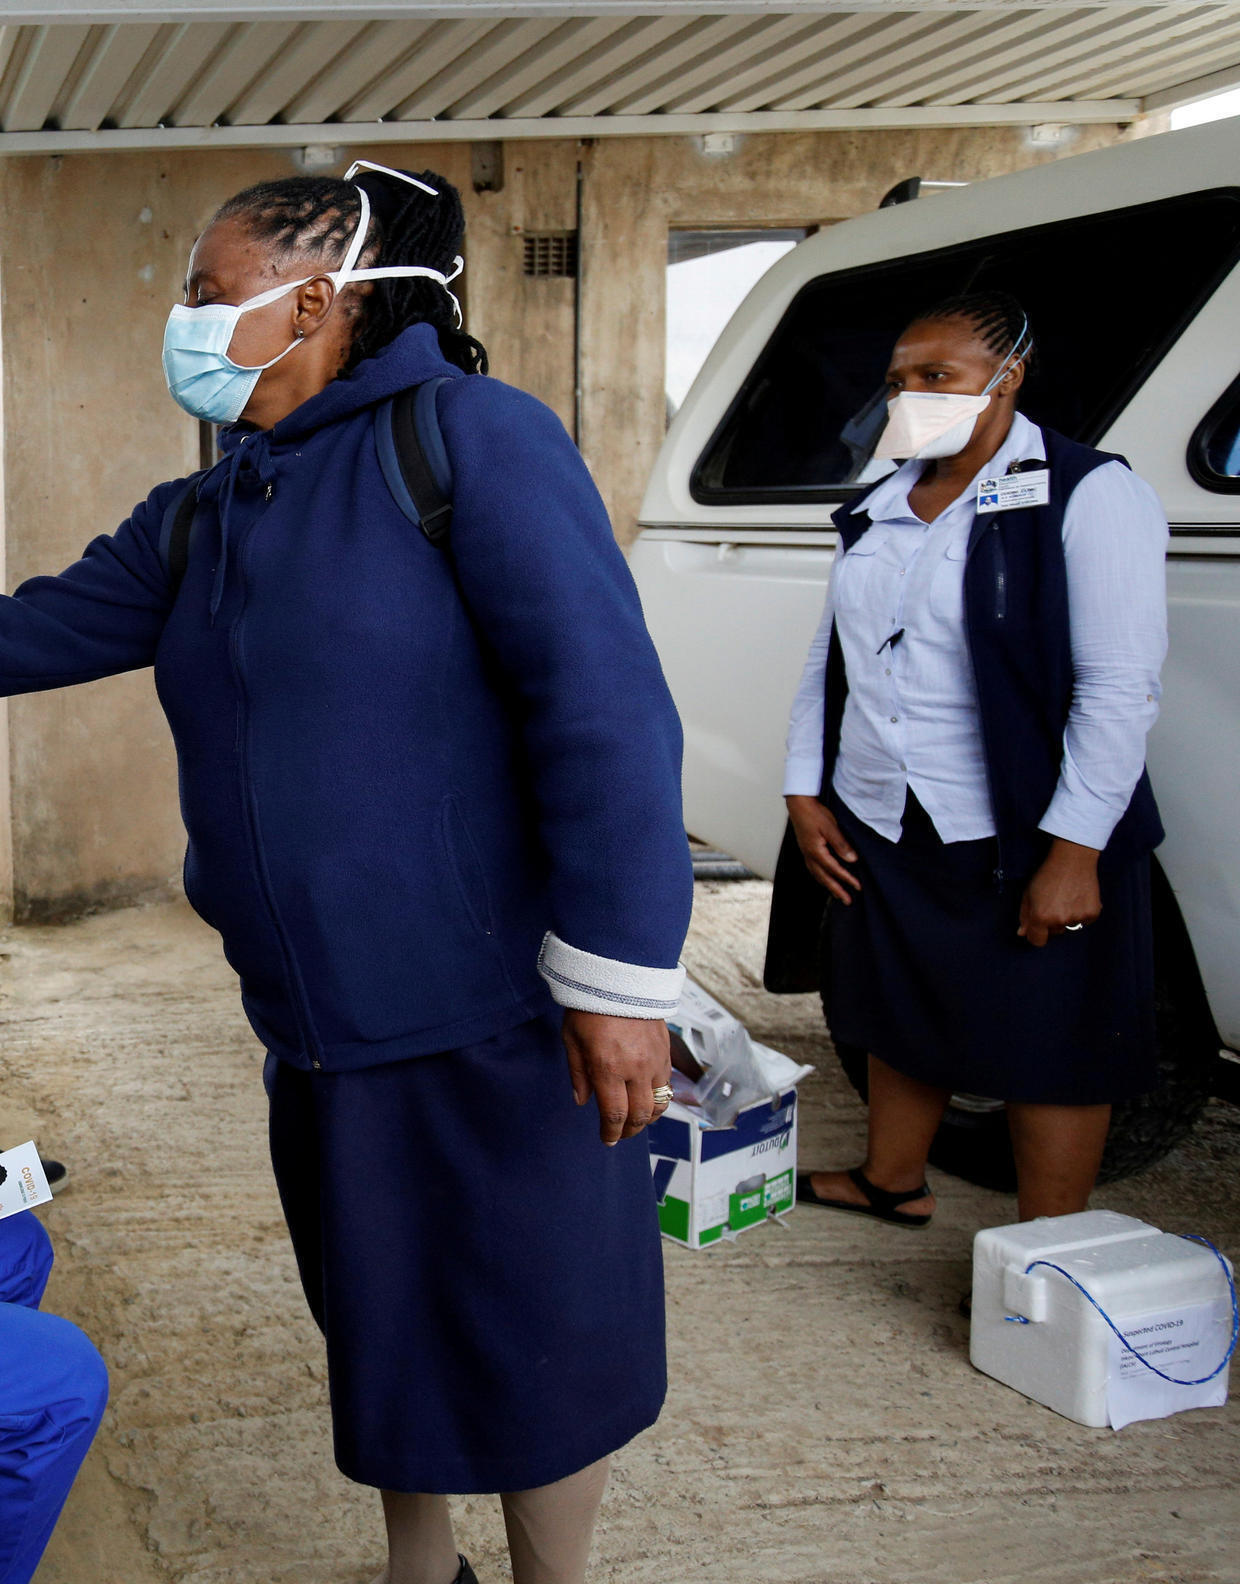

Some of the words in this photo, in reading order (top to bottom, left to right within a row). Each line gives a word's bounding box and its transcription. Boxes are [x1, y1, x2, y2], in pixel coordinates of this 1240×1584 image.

[21, 1167, 38, 1201] COVID-19
[1123, 1326, 1154, 1337] Suspected
[1154, 1319, 1184, 1331] COVID-19
